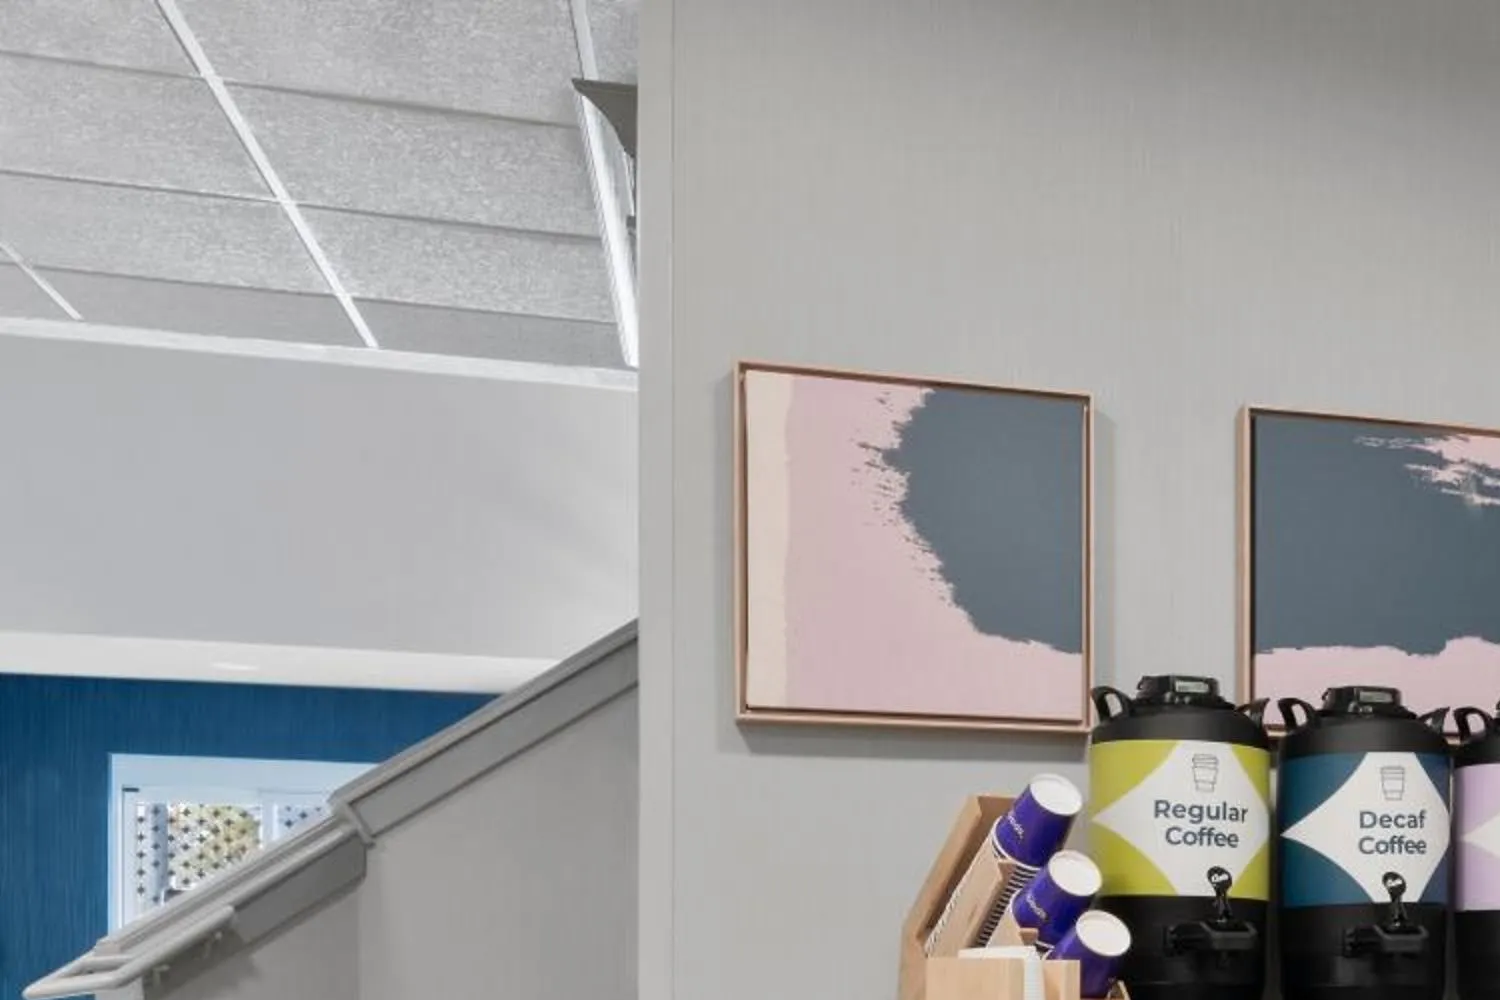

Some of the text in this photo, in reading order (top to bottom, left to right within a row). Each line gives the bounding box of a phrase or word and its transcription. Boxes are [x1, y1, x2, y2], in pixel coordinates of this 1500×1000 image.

[1154, 799, 1248, 824] Regular
[1359, 809, 1427, 829] Decaf
[1165, 826, 1239, 848] Coffee
[1358, 835, 1427, 854] Coffee
